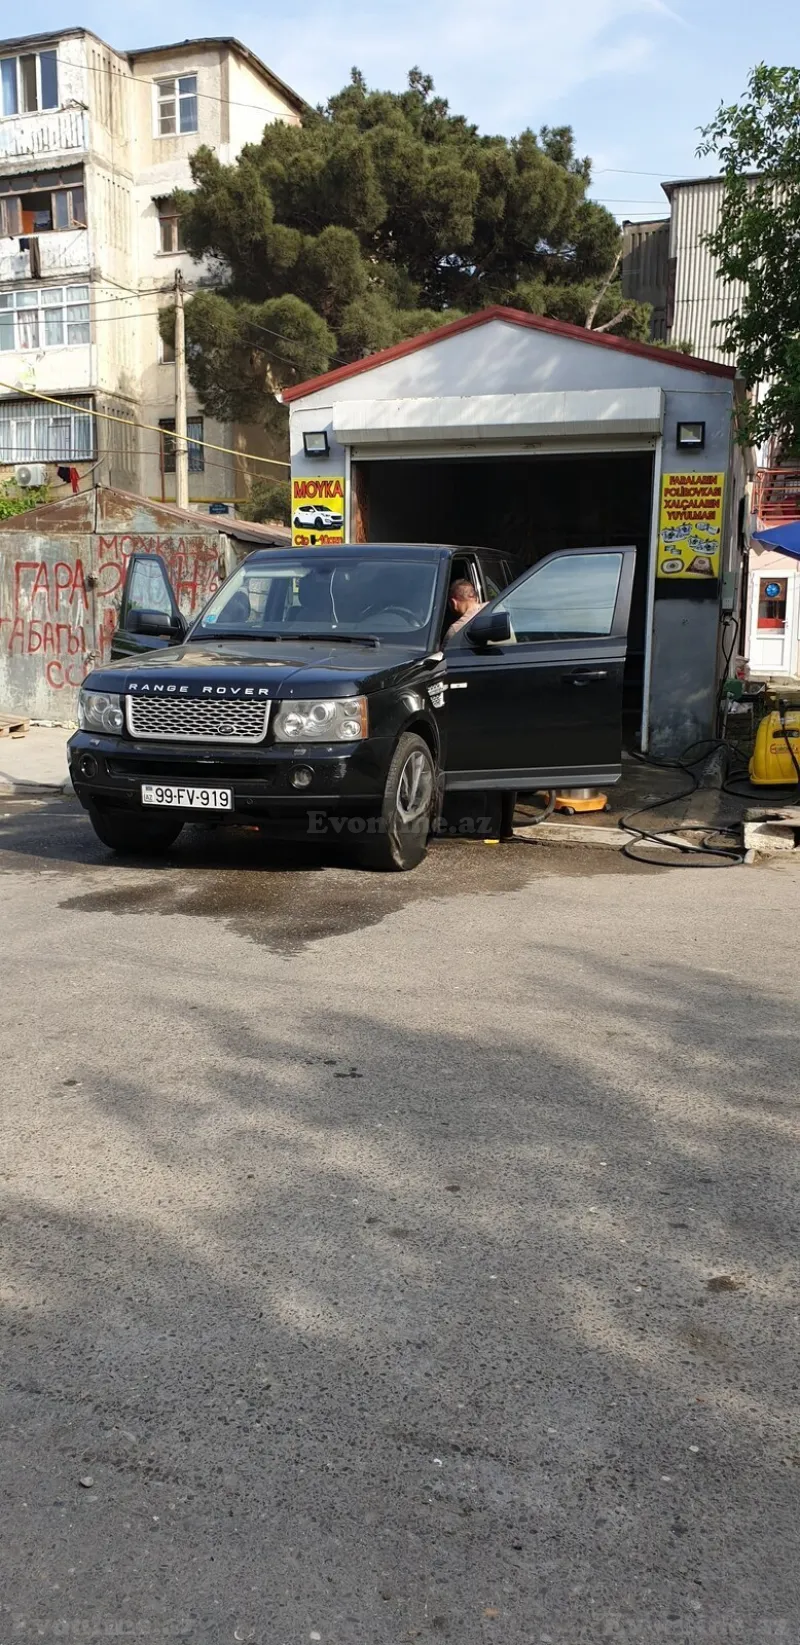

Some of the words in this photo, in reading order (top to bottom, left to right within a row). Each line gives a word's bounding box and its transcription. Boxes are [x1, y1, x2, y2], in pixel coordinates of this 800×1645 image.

[294, 480, 343, 498] MOYKA
[667, 511, 716, 520] YUYULMASI
[128, 683, 189, 693] RANGE
[202, 686, 269, 696] ROVER
[155, 787, 229, 807] 99-FV-919
